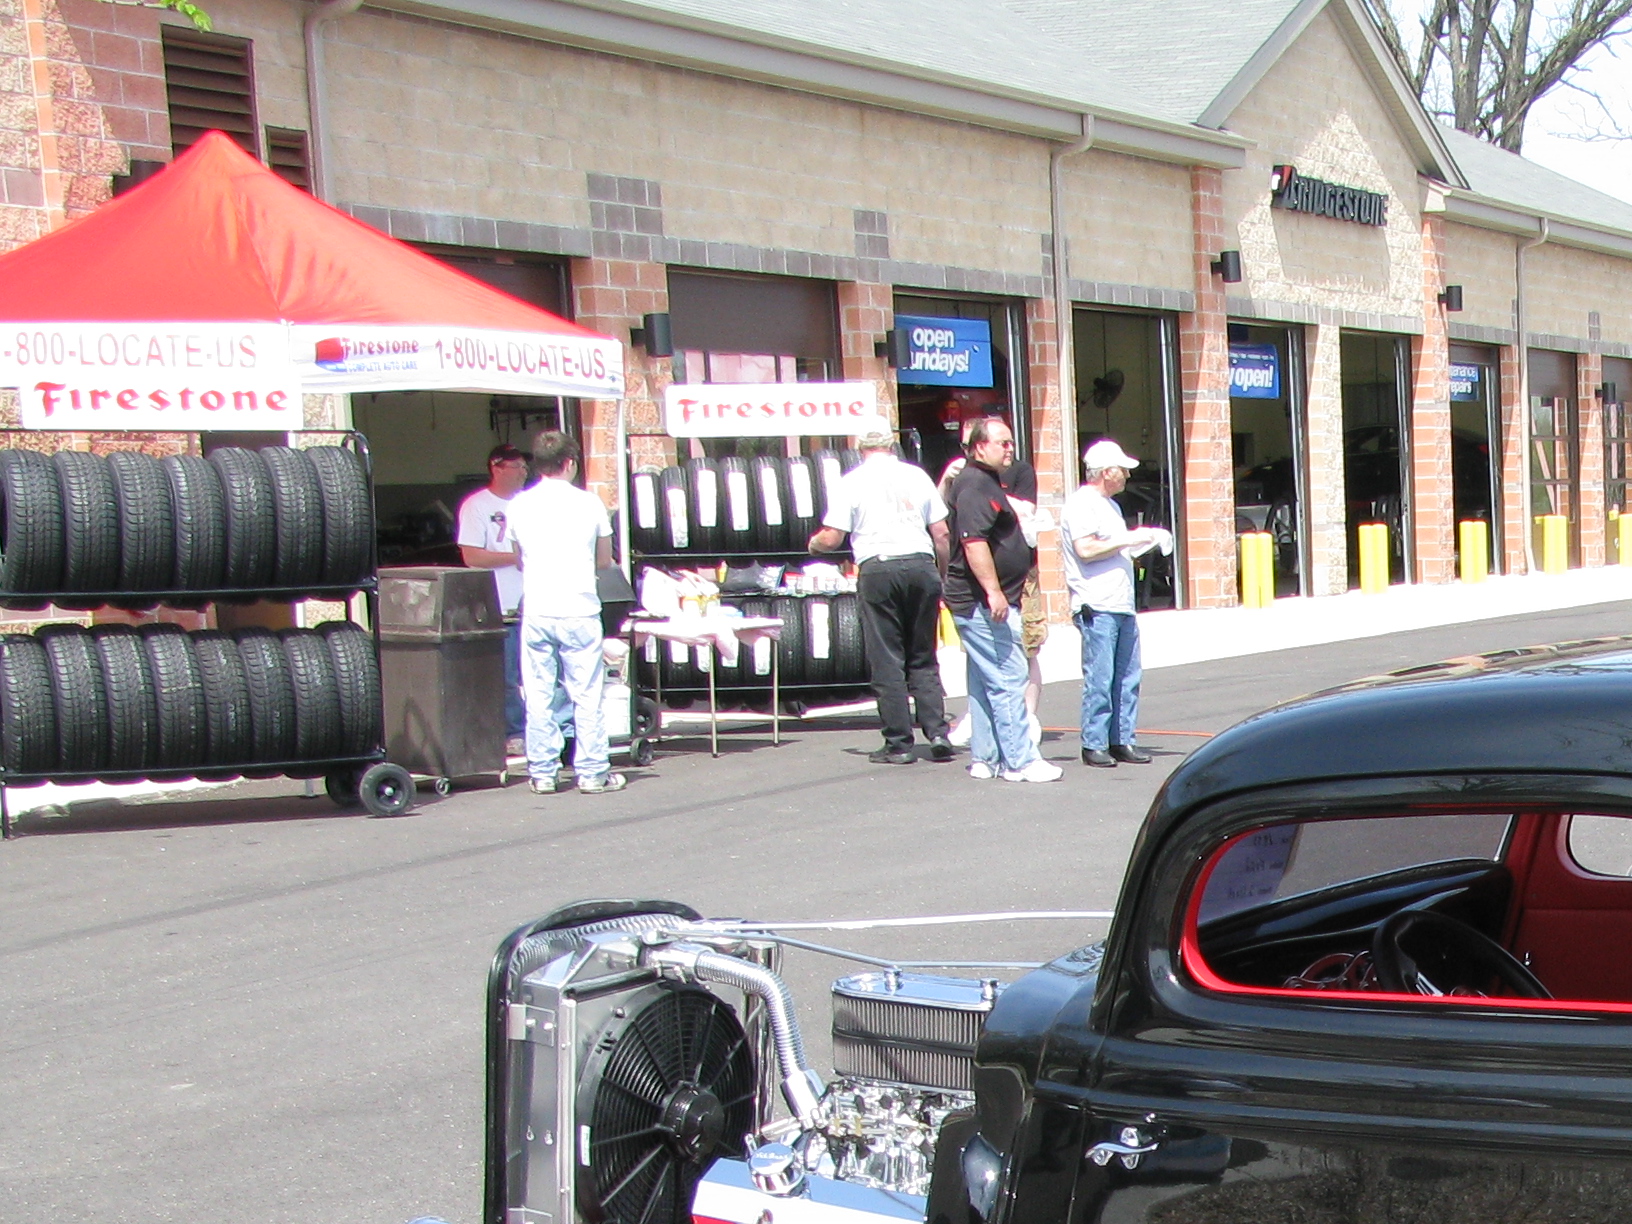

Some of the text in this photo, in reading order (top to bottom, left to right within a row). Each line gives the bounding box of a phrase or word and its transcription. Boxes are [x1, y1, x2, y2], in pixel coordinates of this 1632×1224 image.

[1271, 165, 1388, 226] BRIDGESTONE
[341, 337, 420, 361] Firestone
[912, 327, 954, 352] open
[434, 336, 606, 380] 1-800-LOCATE-US
[902, 348, 970, 378] undays!
[33, 381, 289, 418] Firestone
[676, 398, 866, 425] Firestone
